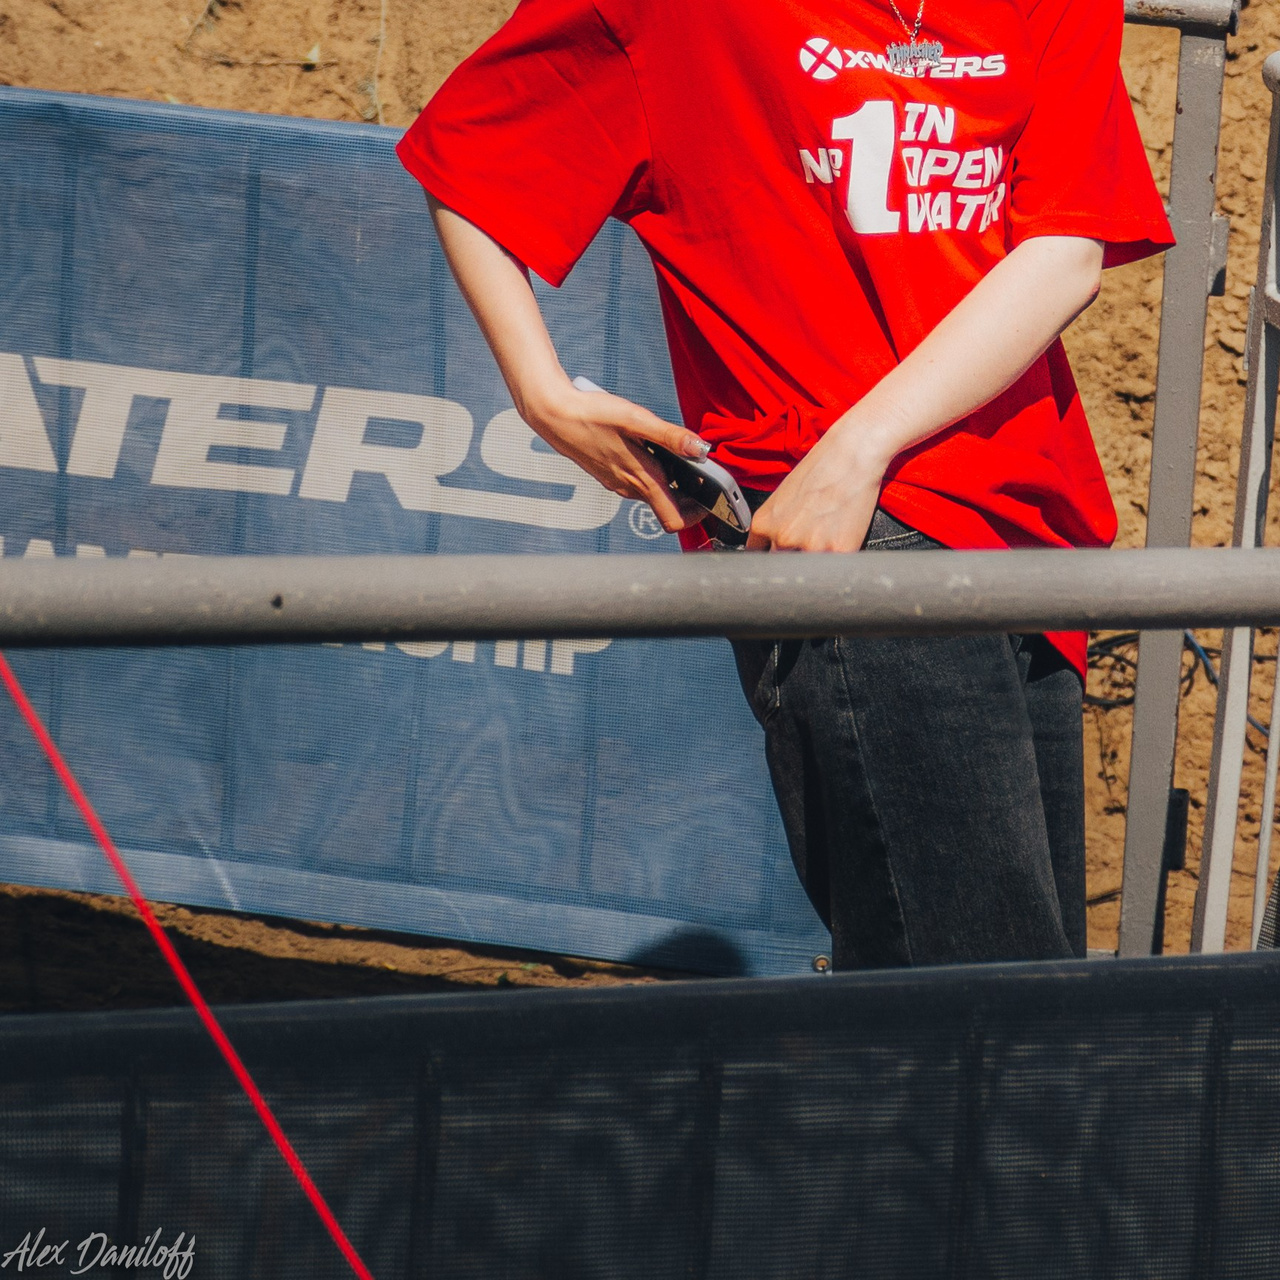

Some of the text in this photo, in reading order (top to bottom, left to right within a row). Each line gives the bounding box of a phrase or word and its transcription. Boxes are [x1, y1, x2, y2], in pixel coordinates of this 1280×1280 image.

[900, 102, 955, 143] IN
[831, 100, 900, 234] 1
[901, 145, 1003, 189] OPEN
